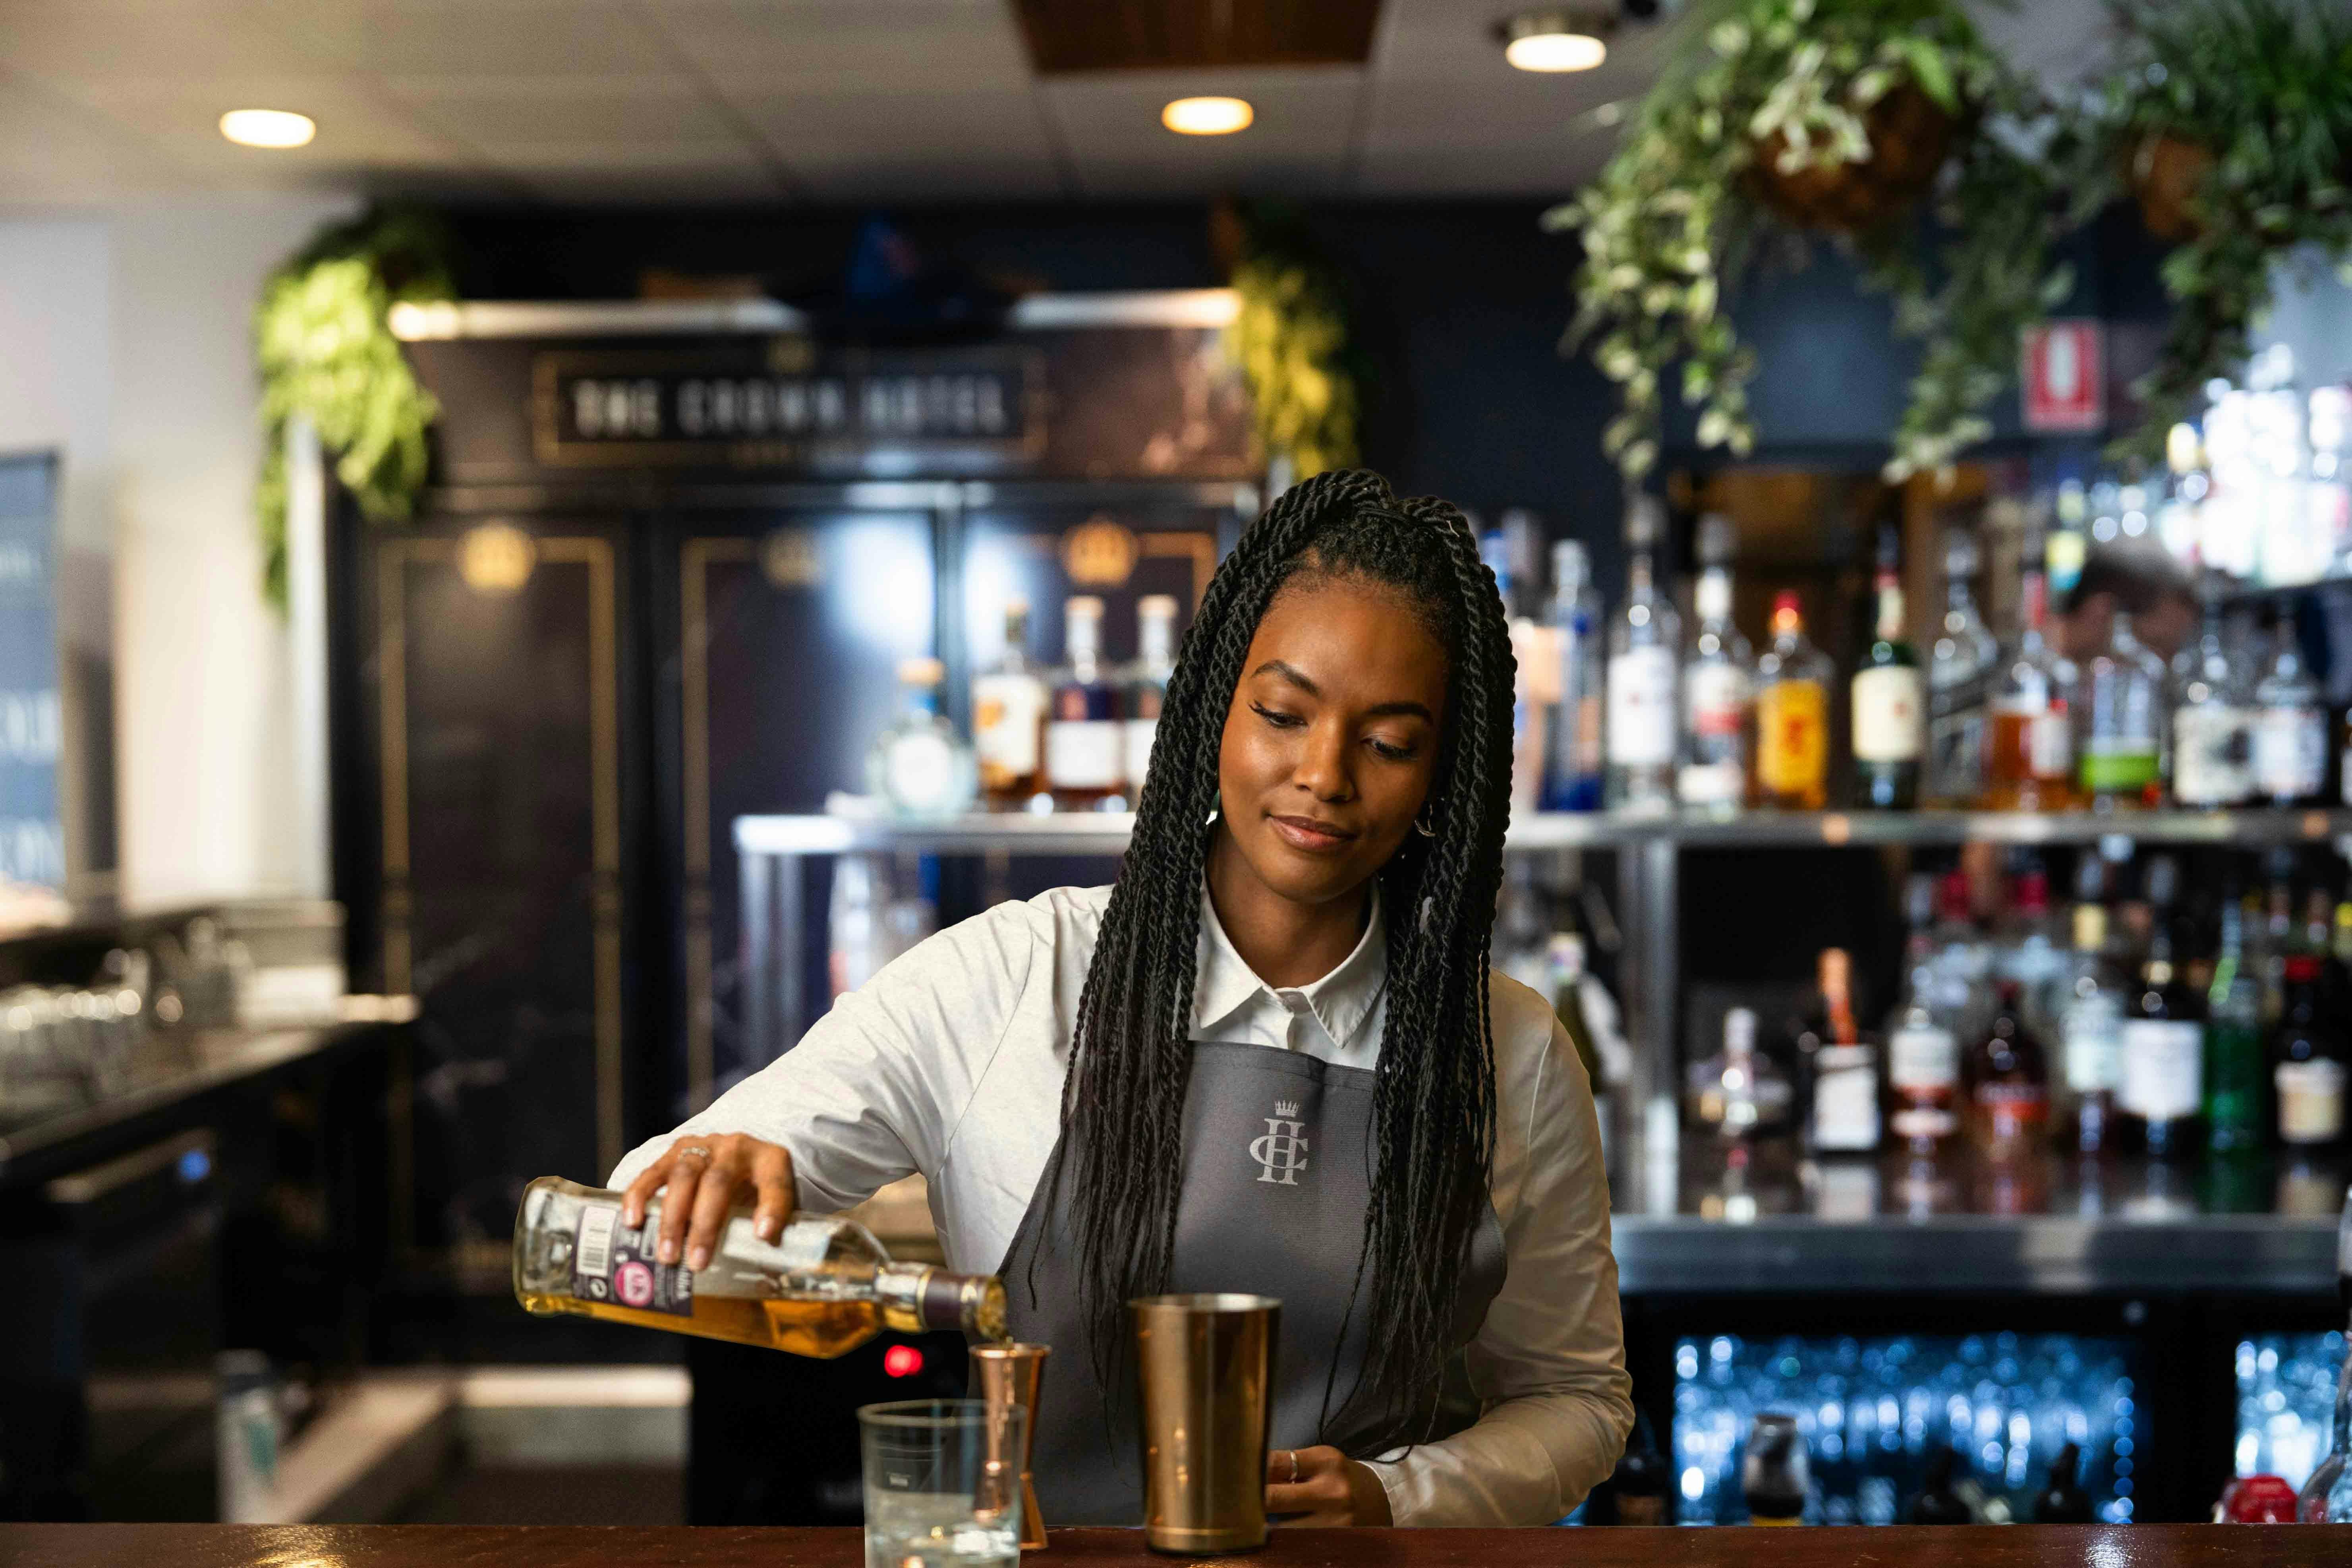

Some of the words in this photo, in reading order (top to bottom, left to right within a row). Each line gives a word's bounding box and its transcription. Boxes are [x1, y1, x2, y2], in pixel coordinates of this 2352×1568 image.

[574, 380, 659, 436] THE
[679, 380, 843, 435] CROWN
[864, 377, 1006, 433] HOTEL
